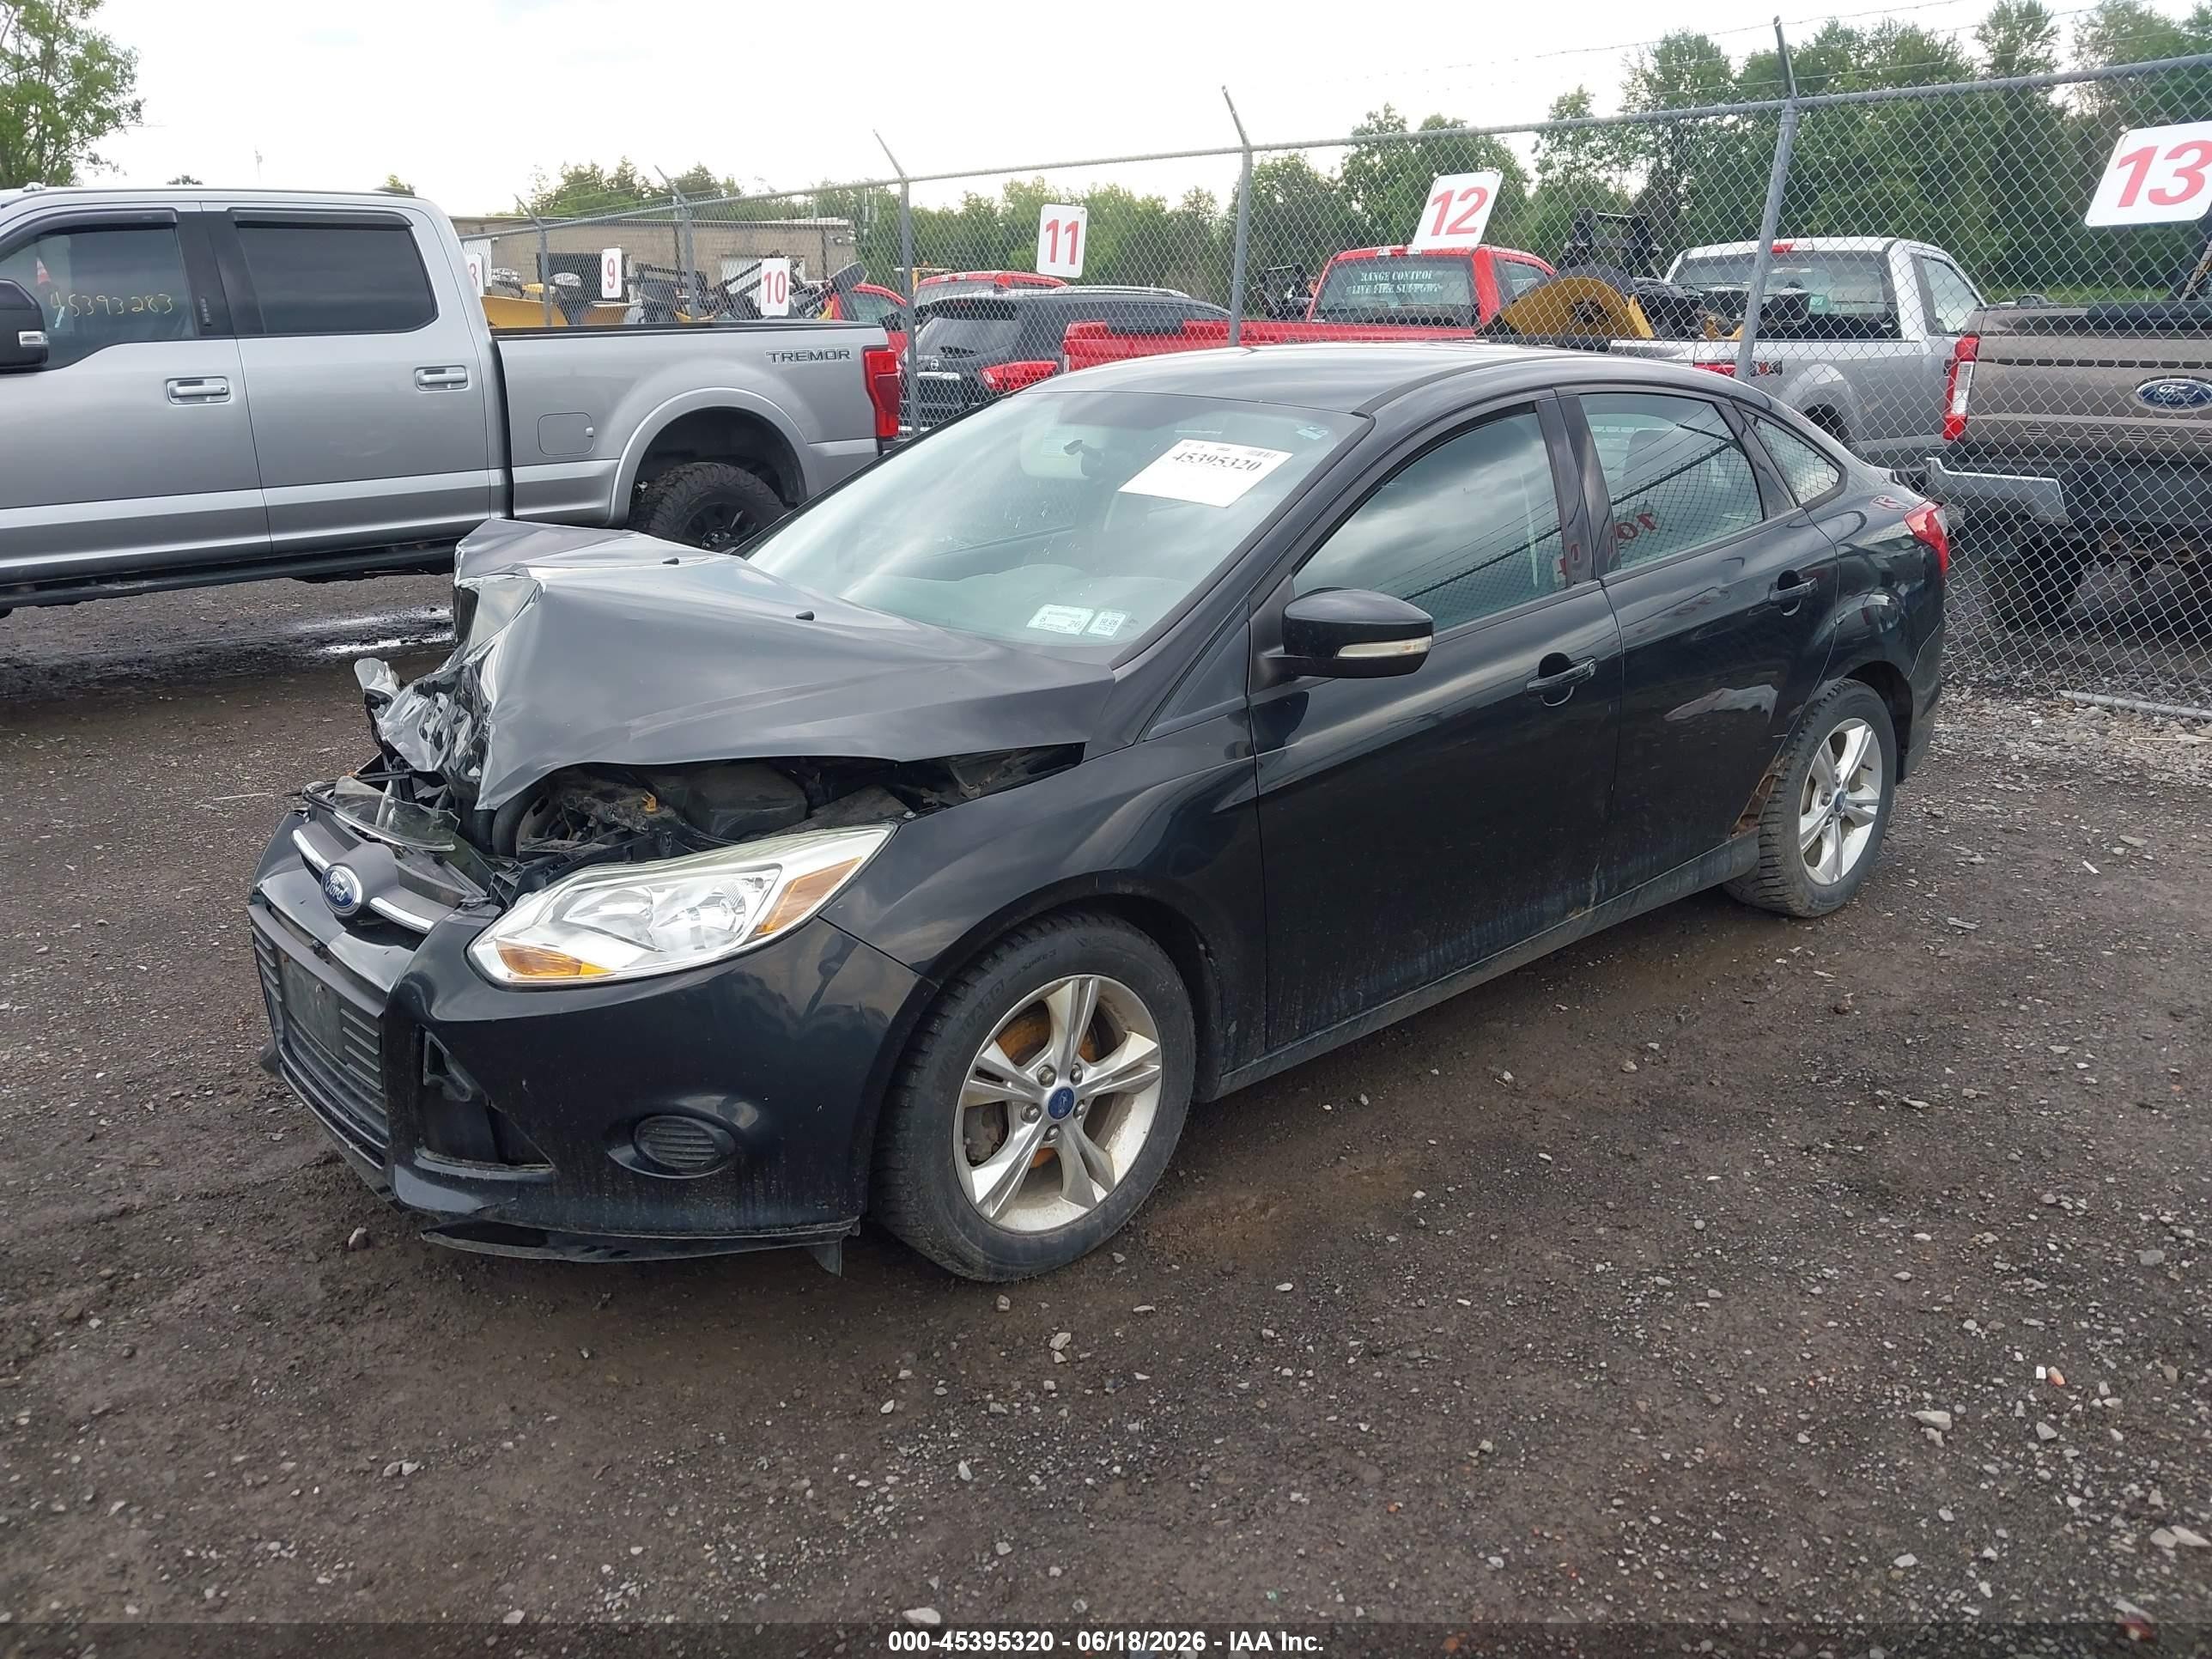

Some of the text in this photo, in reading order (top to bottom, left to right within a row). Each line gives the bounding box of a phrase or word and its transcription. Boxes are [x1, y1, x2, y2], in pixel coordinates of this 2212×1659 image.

[2117, 140, 2212, 207] 13
[1431, 186, 1488, 236] 12
[1046, 219, 1079, 264] 11
[606, 258, 617, 289] 9
[763, 270, 787, 304] 10
[50, 291, 173, 317] 45393283
[765, 349, 853, 364] TREMOR
[1172, 451, 1263, 472] 45395320
